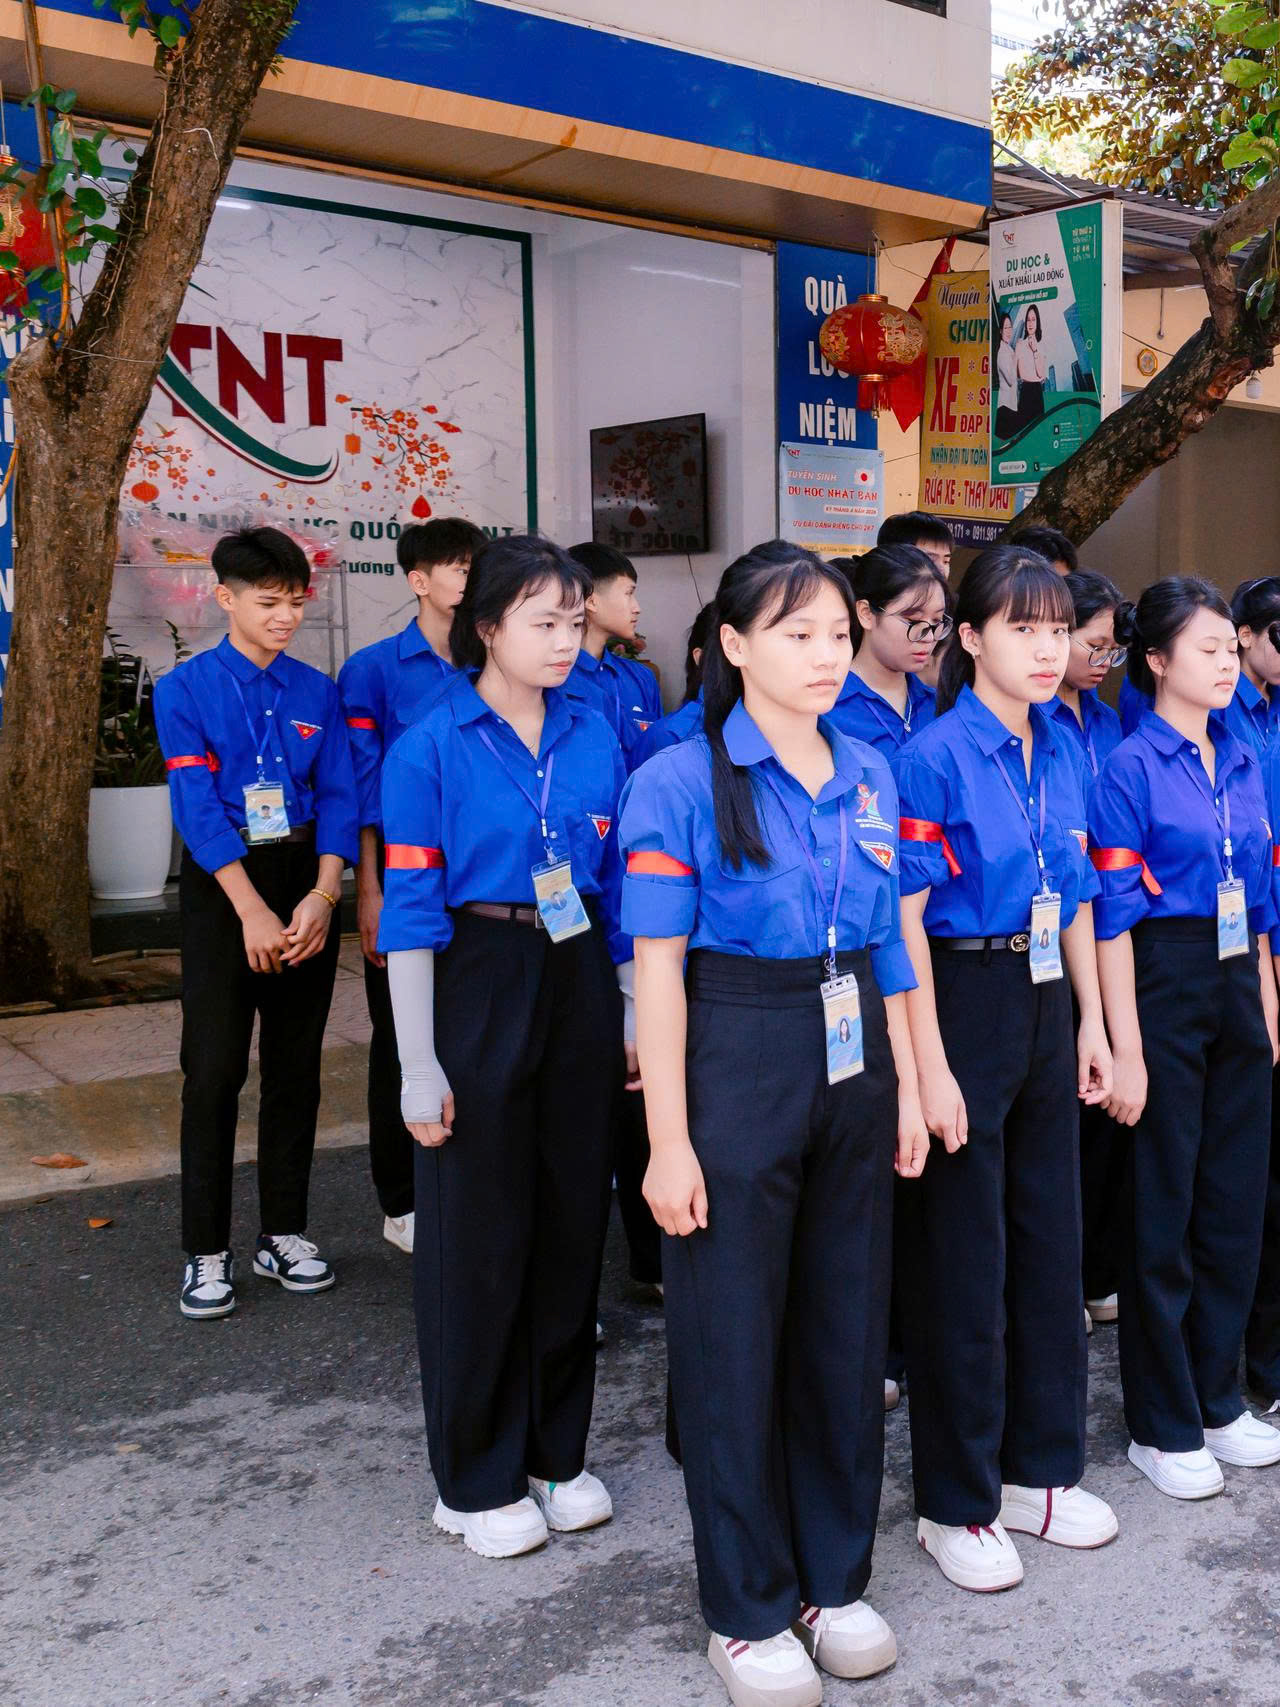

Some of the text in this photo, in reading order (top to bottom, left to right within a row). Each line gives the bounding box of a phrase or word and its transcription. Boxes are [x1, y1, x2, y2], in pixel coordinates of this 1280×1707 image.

[1006, 253, 1050, 272] DU HỌC &
[999, 273, 1014, 288] XUẤT
[1033, 271, 1045, 283] LAO
[1046, 268, 1064, 282] ĐỘNG
[805, 275, 848, 316] QUÀ
[930, 357, 959, 433] XE
[800, 398, 856, 446] NIỆM
[960, 415, 982, 437] ĐẠP
[816, 473, 837, 482] SINH
[788, 485, 800, 495] DU
[945, 479, 956, 505] XE
[964, 480, 987, 509] THAY
[350, 513, 400, 540] QUỐ
